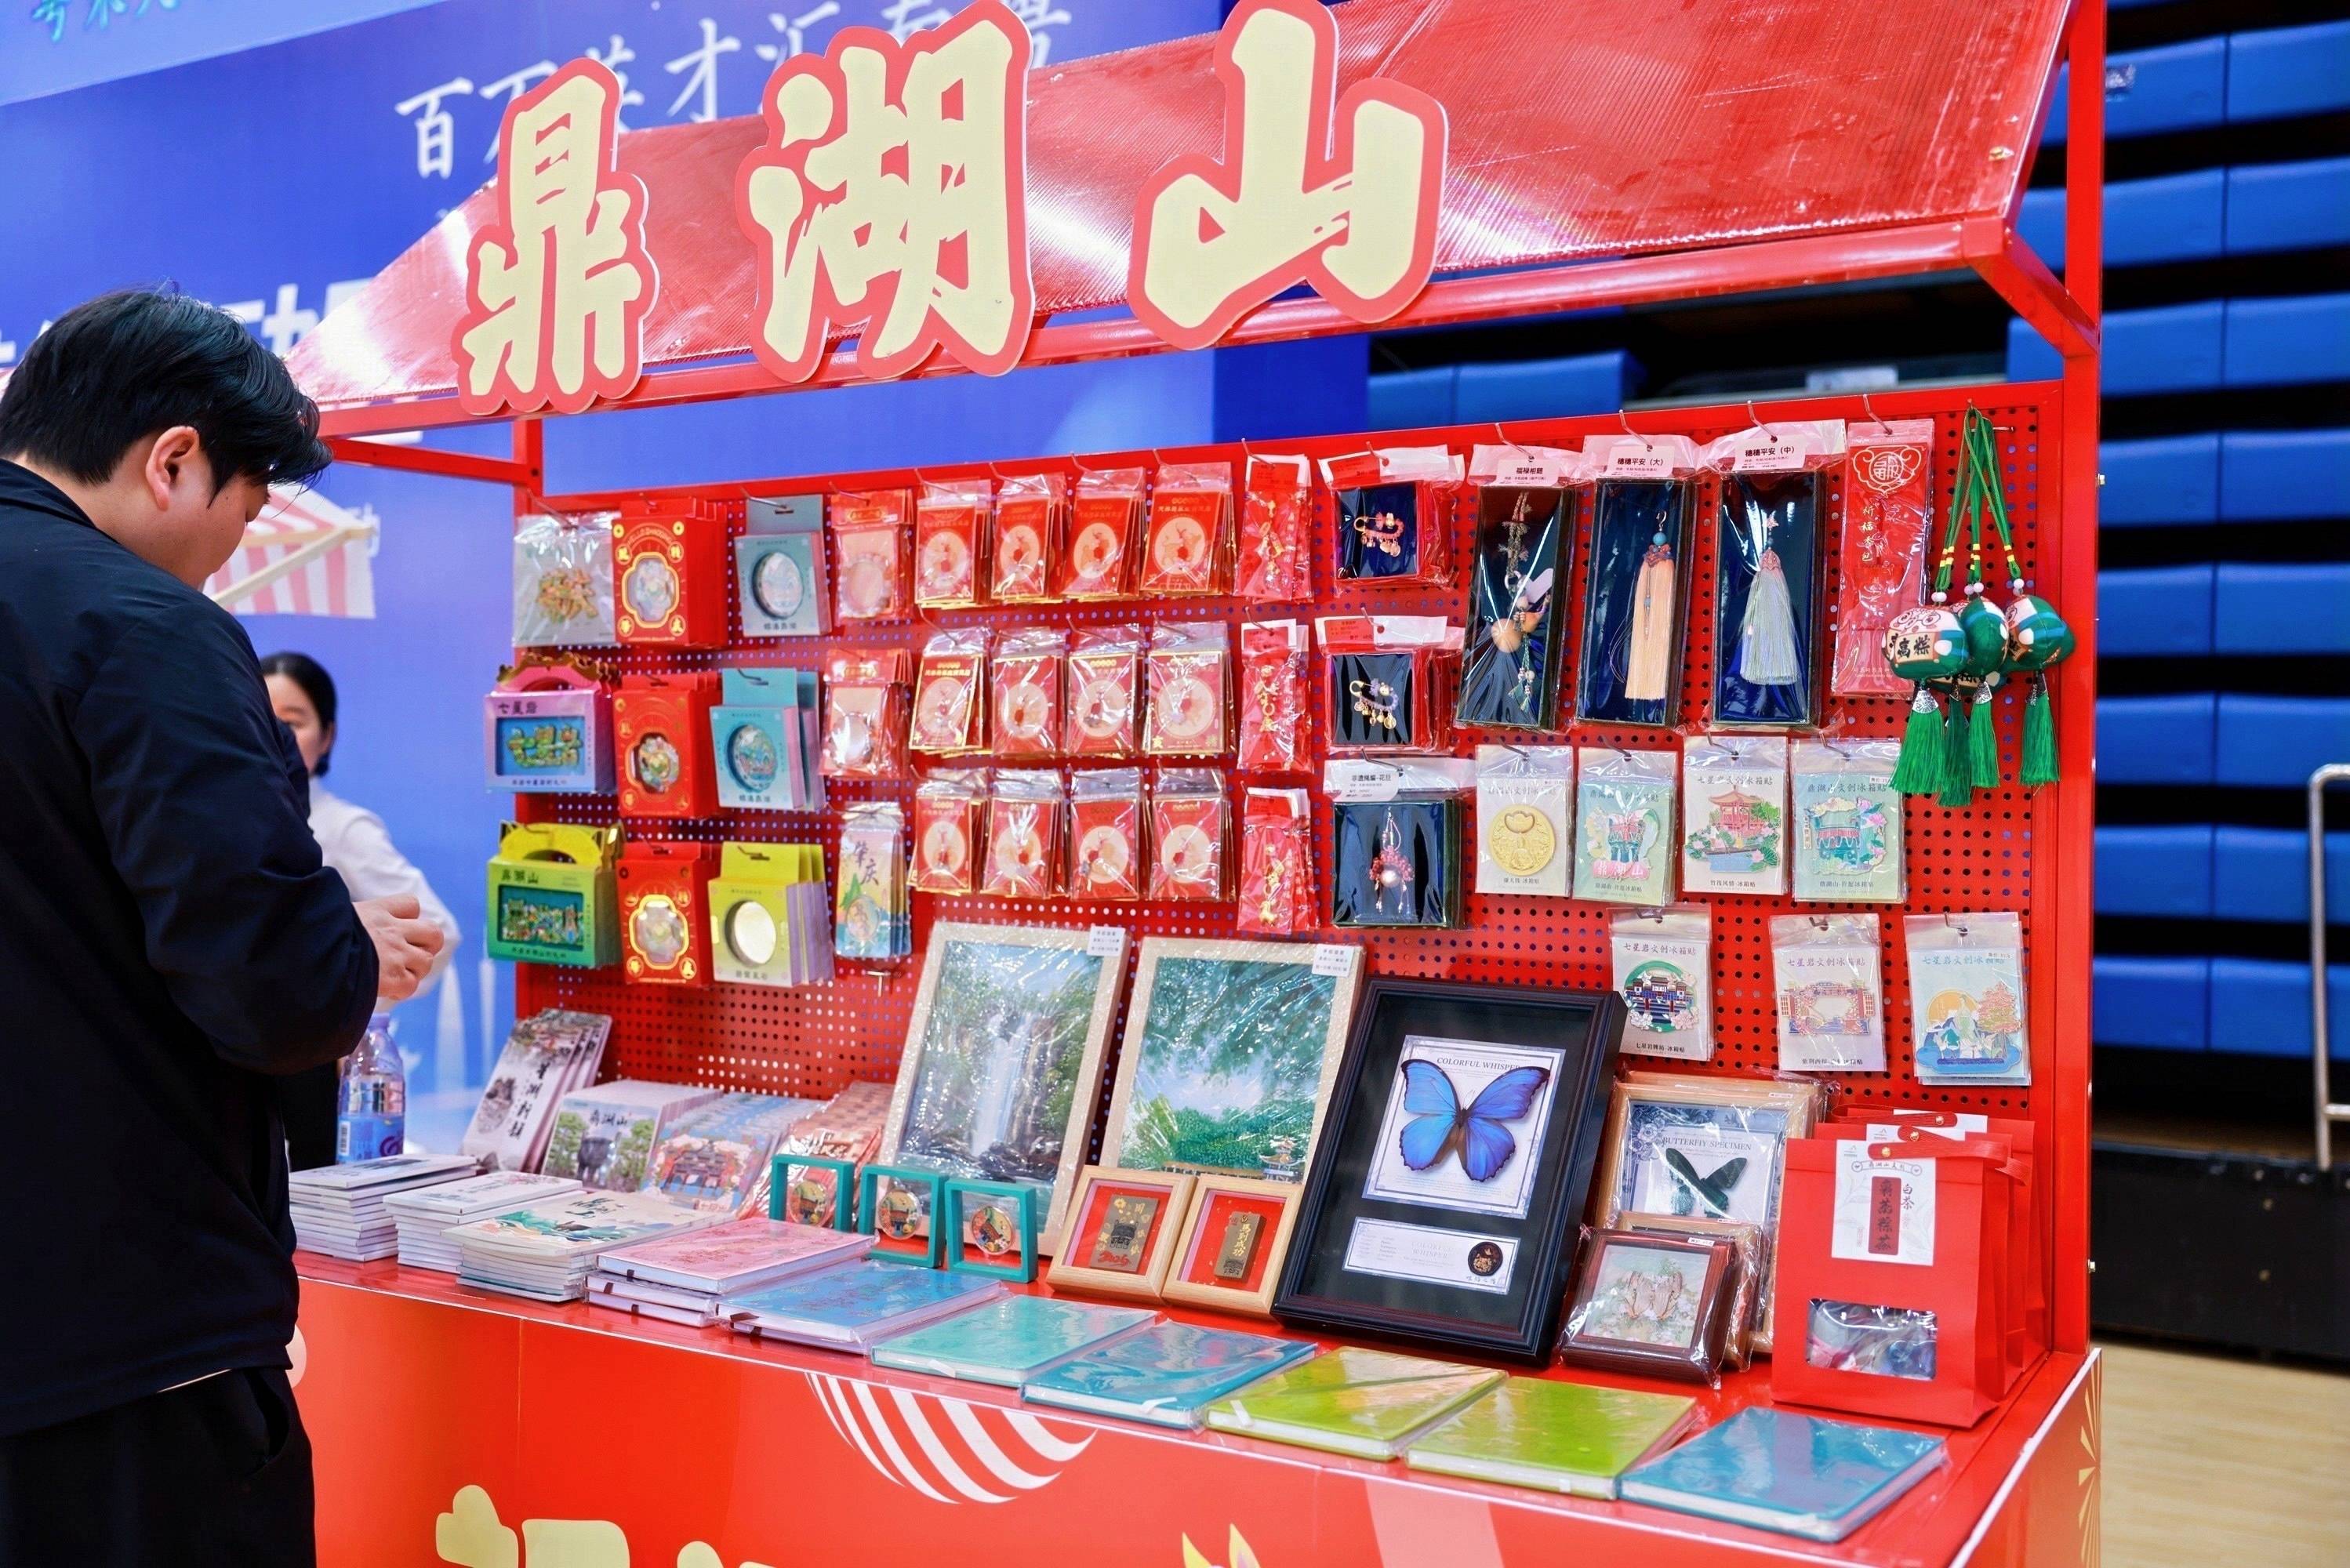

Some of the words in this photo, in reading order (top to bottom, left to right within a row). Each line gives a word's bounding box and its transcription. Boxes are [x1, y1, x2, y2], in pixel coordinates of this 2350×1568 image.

[461, 6, 1426, 397] 鼎湖山
[1623, 942, 1696, 955] 七星岩文创冰箱贴
[1437, 1057, 1481, 1068] COLORFUL
[1709, 1140, 1752, 1151] SPECIMEN
[1901, 1184, 1915, 1210] 白茶
